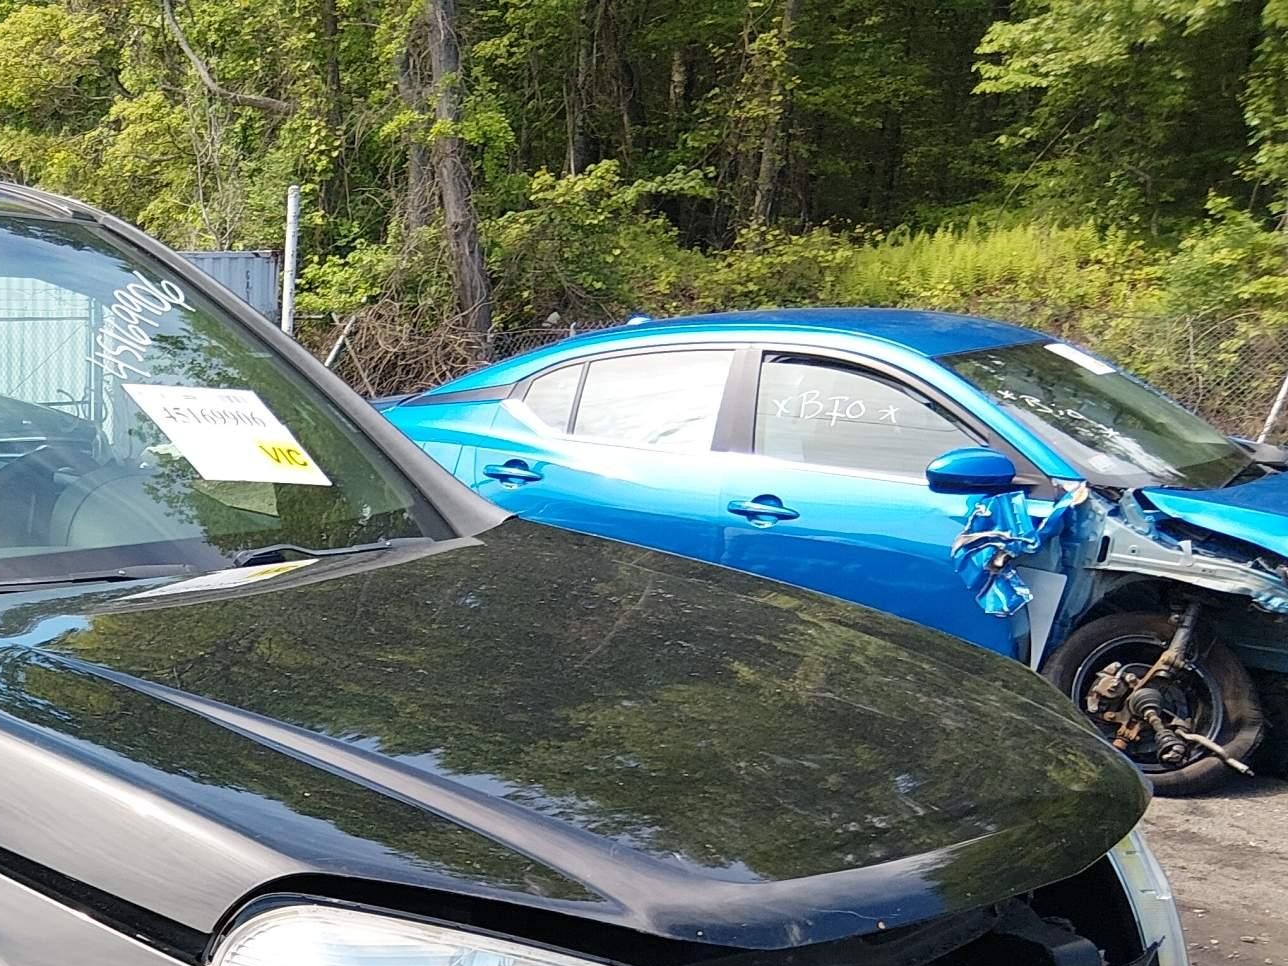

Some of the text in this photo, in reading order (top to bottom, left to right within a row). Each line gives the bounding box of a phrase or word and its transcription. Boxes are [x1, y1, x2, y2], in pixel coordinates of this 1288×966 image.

[86, 270, 196, 379] 45169906
[161, 406, 266, 428] 45169906
[260, 444, 309, 467] VIC
